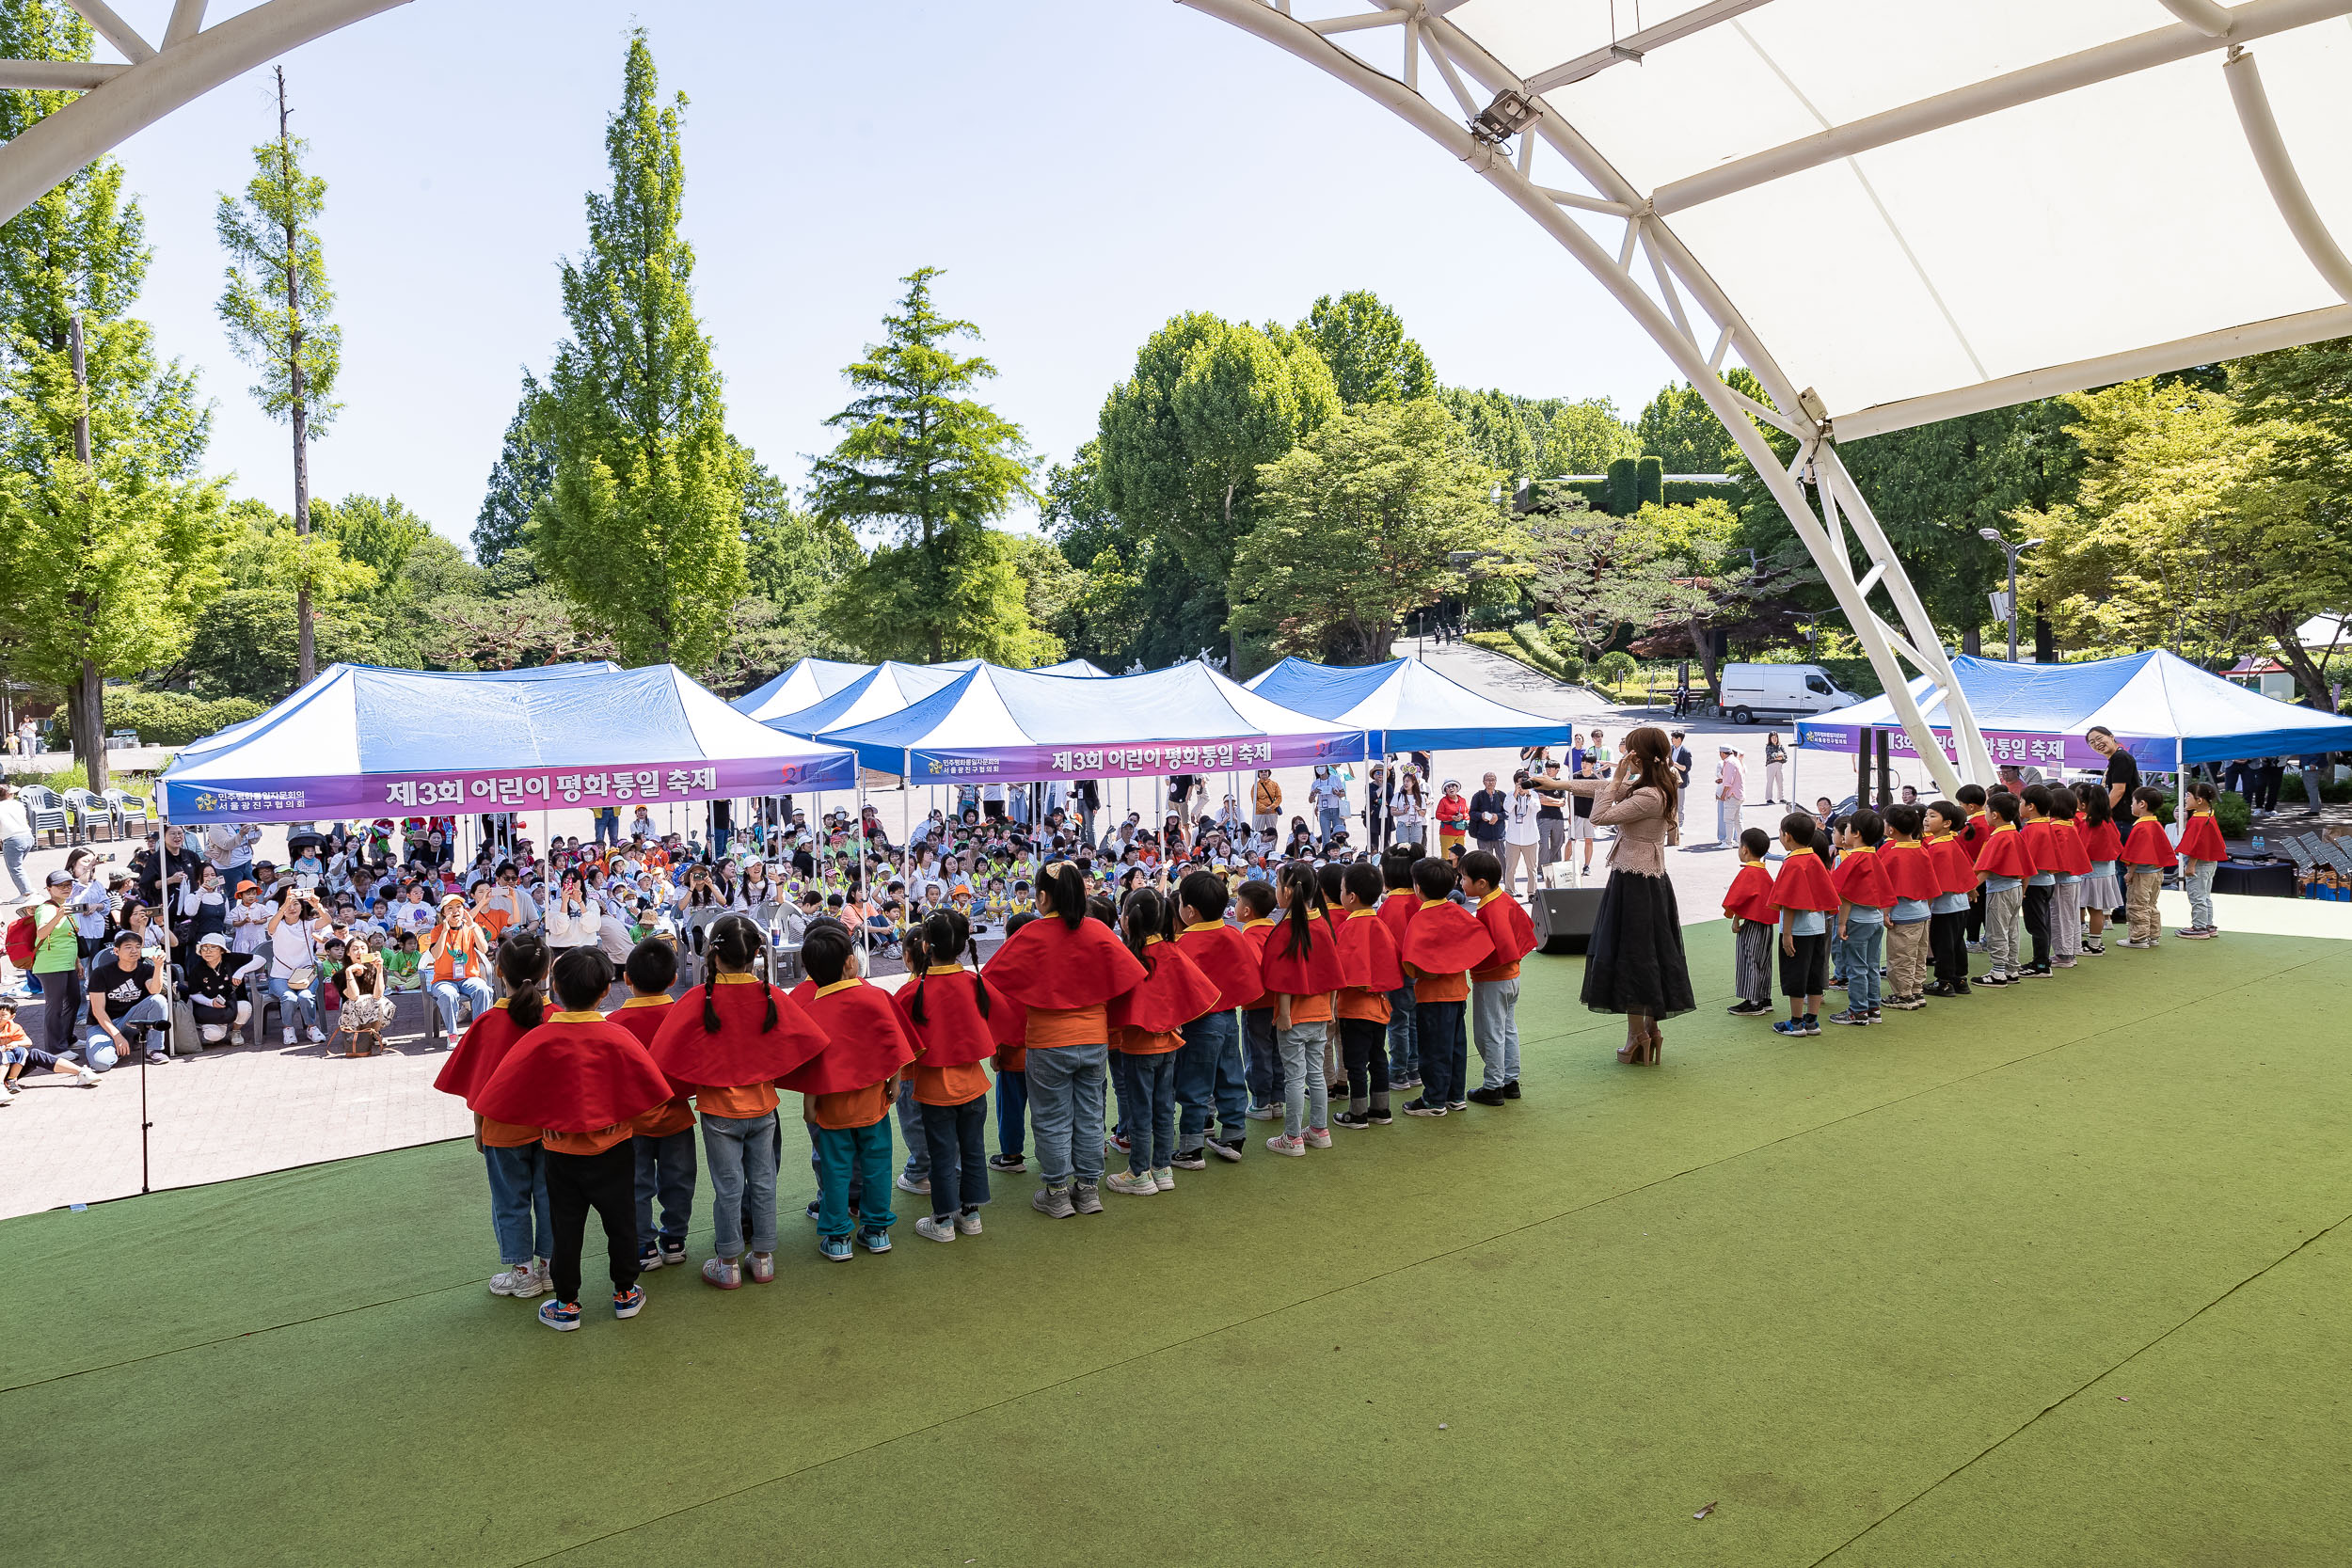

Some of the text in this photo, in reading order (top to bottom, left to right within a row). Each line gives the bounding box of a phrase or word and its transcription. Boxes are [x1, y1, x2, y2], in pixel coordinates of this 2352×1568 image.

[1051, 741, 1272, 772] 제3회 어린이 평화통일 축제
[2030, 739, 2065, 762] 축제
[386, 767, 717, 807] 제3회 어린이 평화통일 축제
[218, 800, 306, 811] 서울광진구협의회
[107, 990, 142, 1000] adidas
